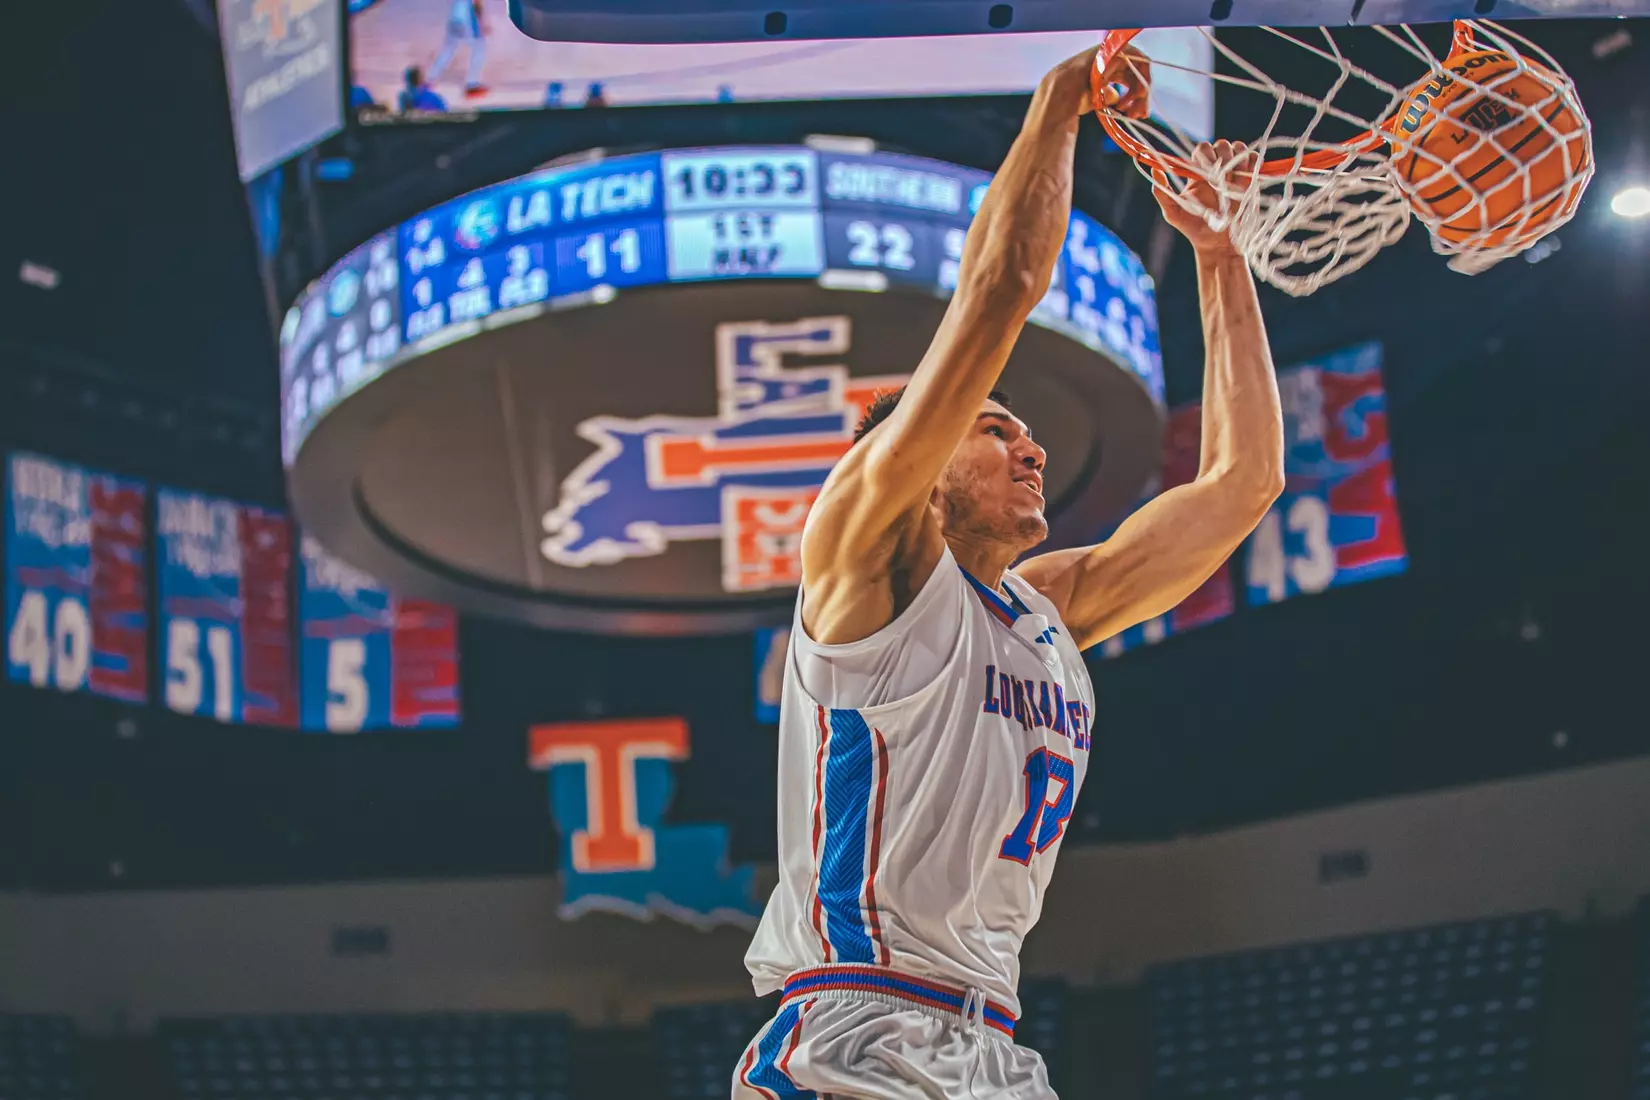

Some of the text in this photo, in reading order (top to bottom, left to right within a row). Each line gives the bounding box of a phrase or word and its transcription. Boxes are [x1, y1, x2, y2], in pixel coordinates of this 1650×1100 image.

[507, 170, 655, 233] LA TECH
[846, 219, 916, 271] 22
[576, 228, 641, 278] 11
[1246, 496, 1336, 602] 43
[8, 589, 91, 693] 40
[165, 617, 233, 723] 51
[325, 637, 369, 734] 5
